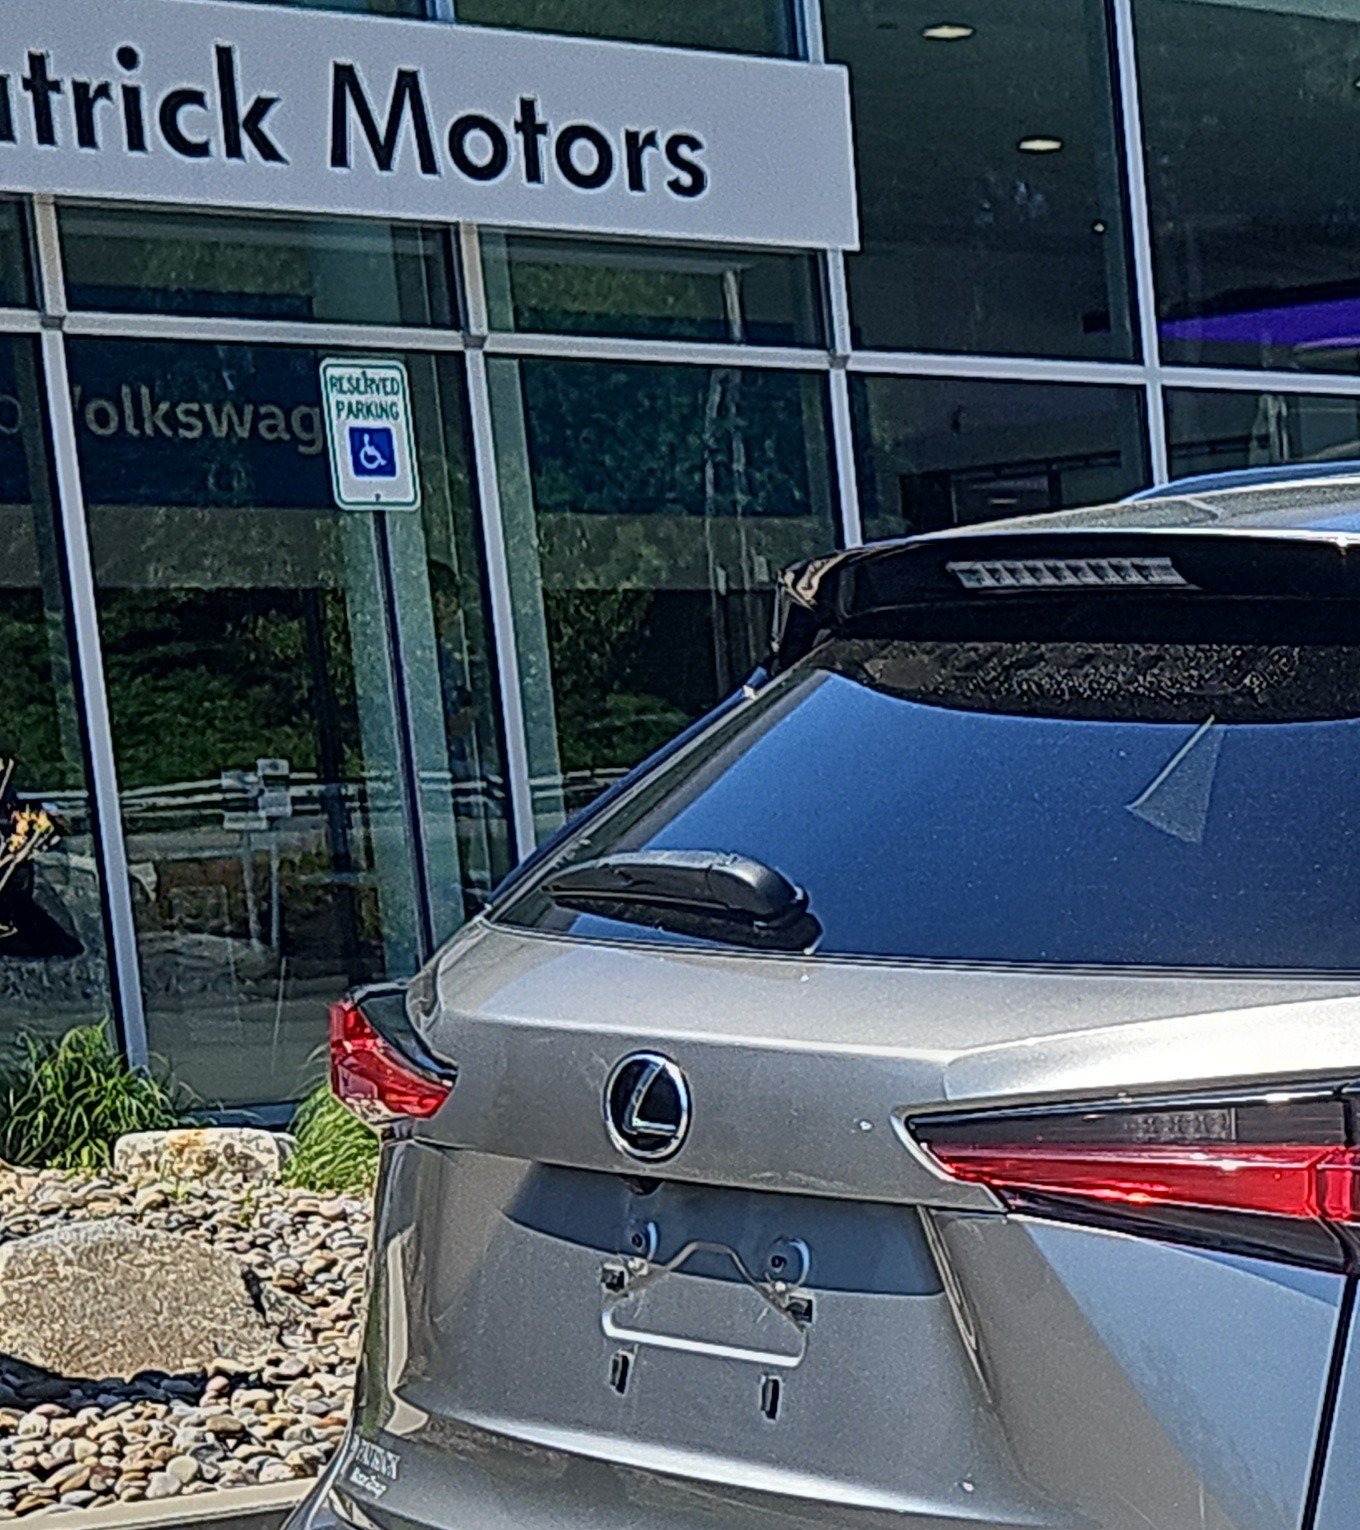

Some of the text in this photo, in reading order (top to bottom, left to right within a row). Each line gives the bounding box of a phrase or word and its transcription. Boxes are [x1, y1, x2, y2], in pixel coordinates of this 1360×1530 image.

[330, 59, 708, 199] Motors
[328, 373, 400, 397] RESERVED
[73, 384, 324, 455] olkswag
[336, 399, 400, 421] PARKING
